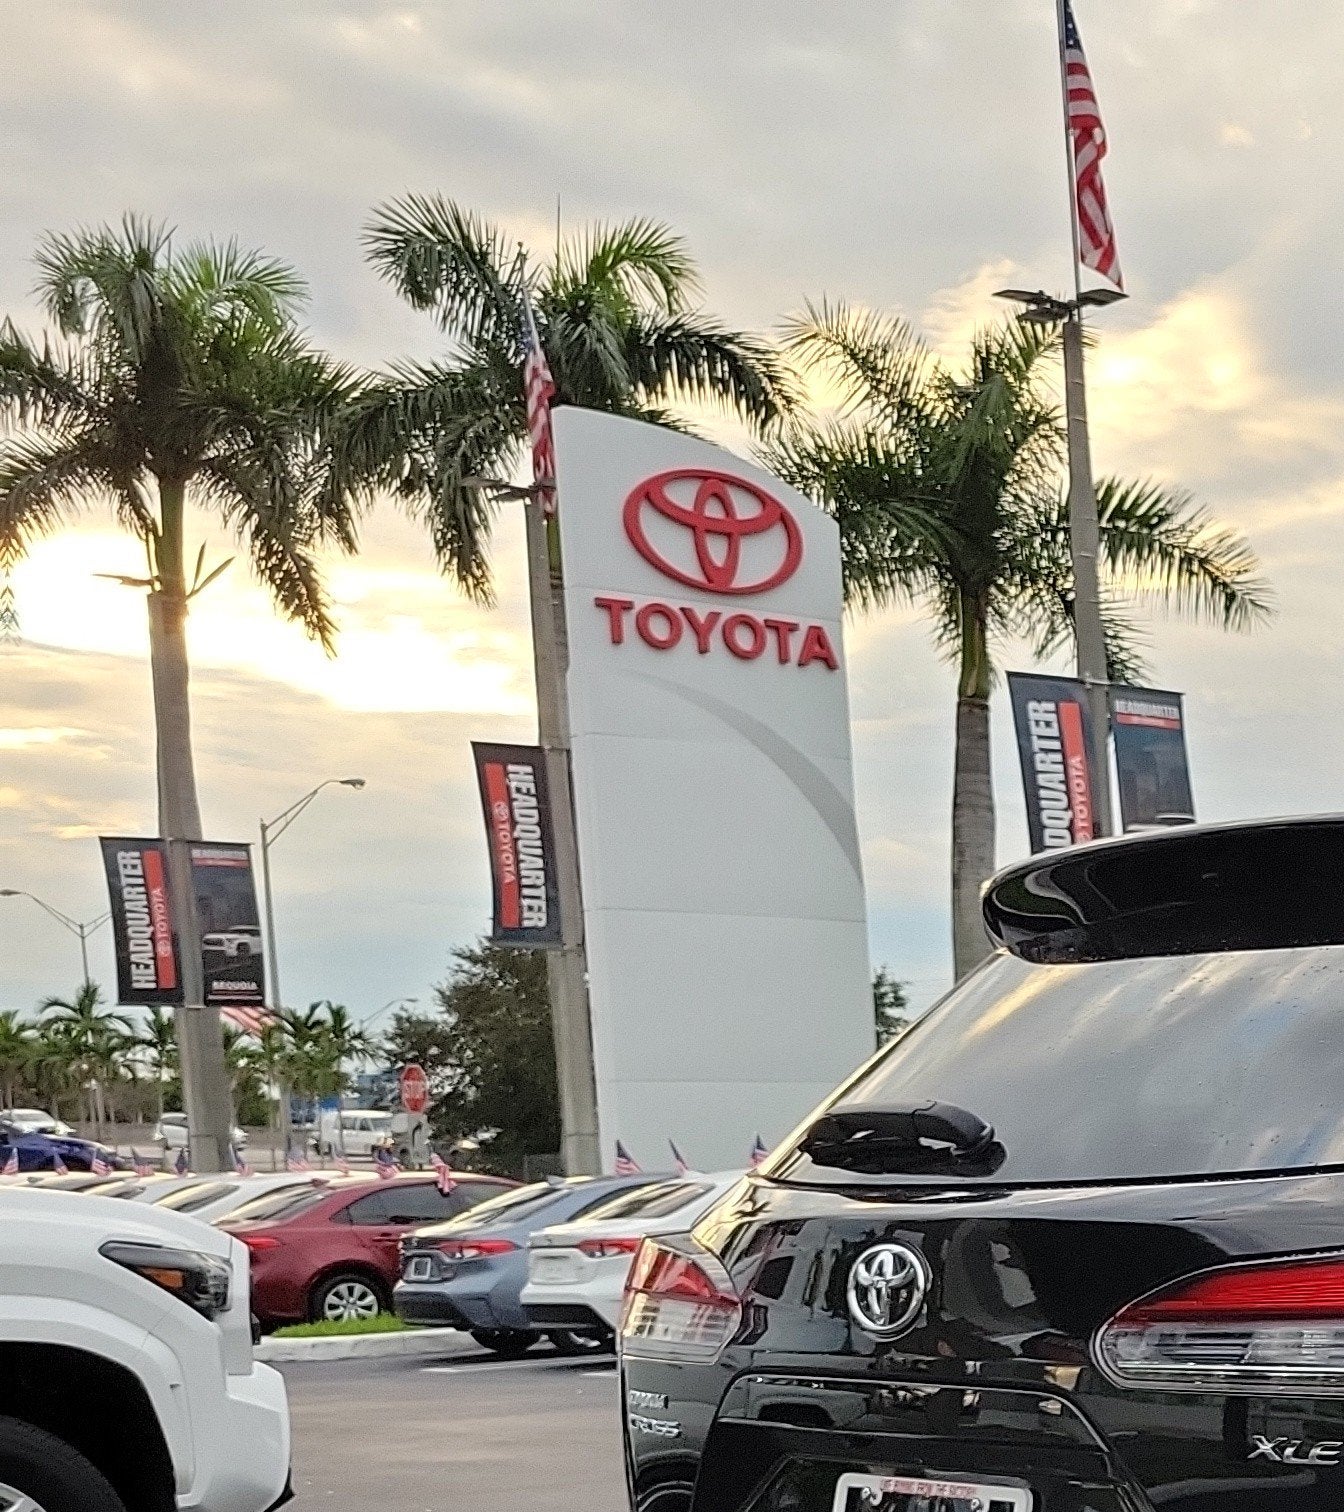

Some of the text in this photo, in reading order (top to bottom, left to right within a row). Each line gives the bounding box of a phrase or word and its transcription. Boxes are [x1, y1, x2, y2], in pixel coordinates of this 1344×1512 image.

[594, 597, 839, 670] TOYOTA
[1027, 700, 1073, 847] DQUARTER
[497, 820, 517, 883] TOYOTA
[506, 764, 547, 928] HEADQUARTER
[117, 850, 157, 990] HEADQUARTER
[152, 888, 172, 942] TOYOTA
[211, 979, 258, 991] SEQUOIA
[1247, 1434, 1344, 1465] XLE
